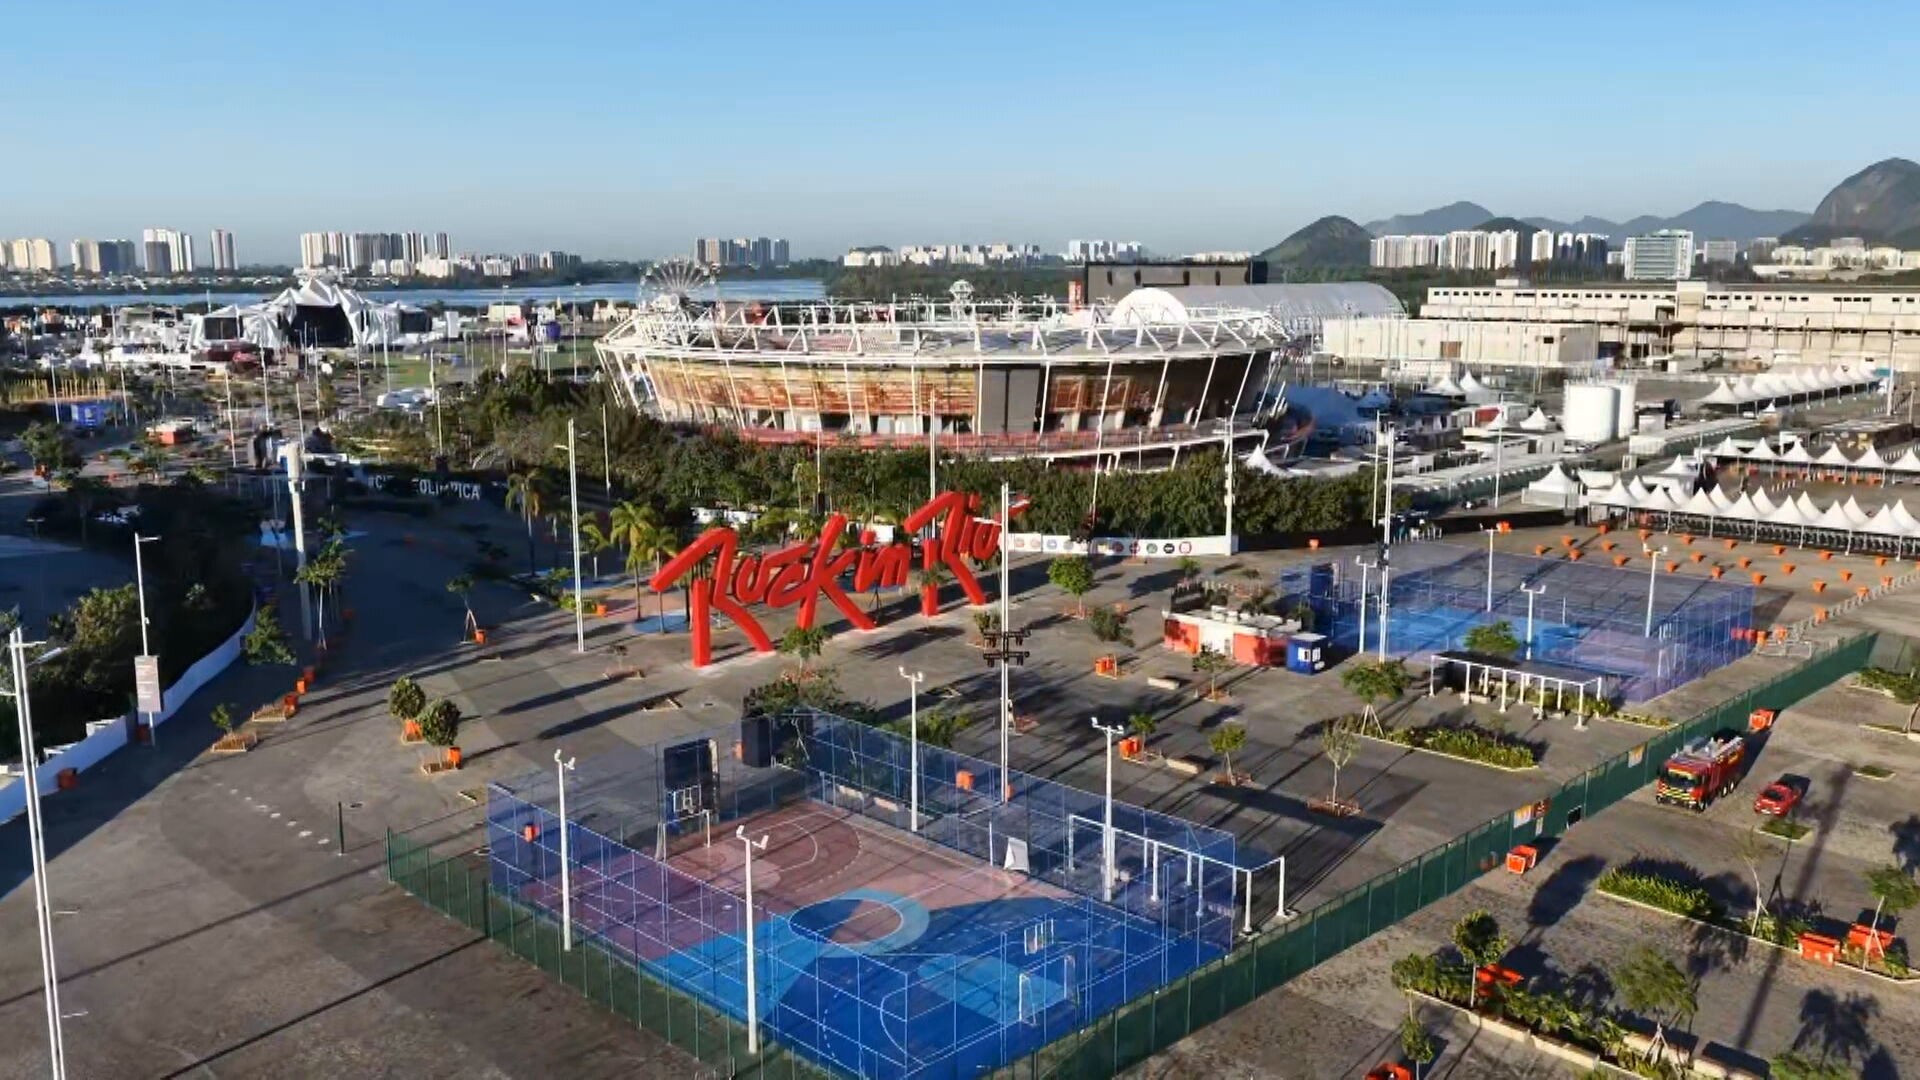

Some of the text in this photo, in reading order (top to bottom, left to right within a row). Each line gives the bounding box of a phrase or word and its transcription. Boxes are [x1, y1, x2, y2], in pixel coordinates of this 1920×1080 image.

[650, 490, 1032, 667] Rock in Rio
